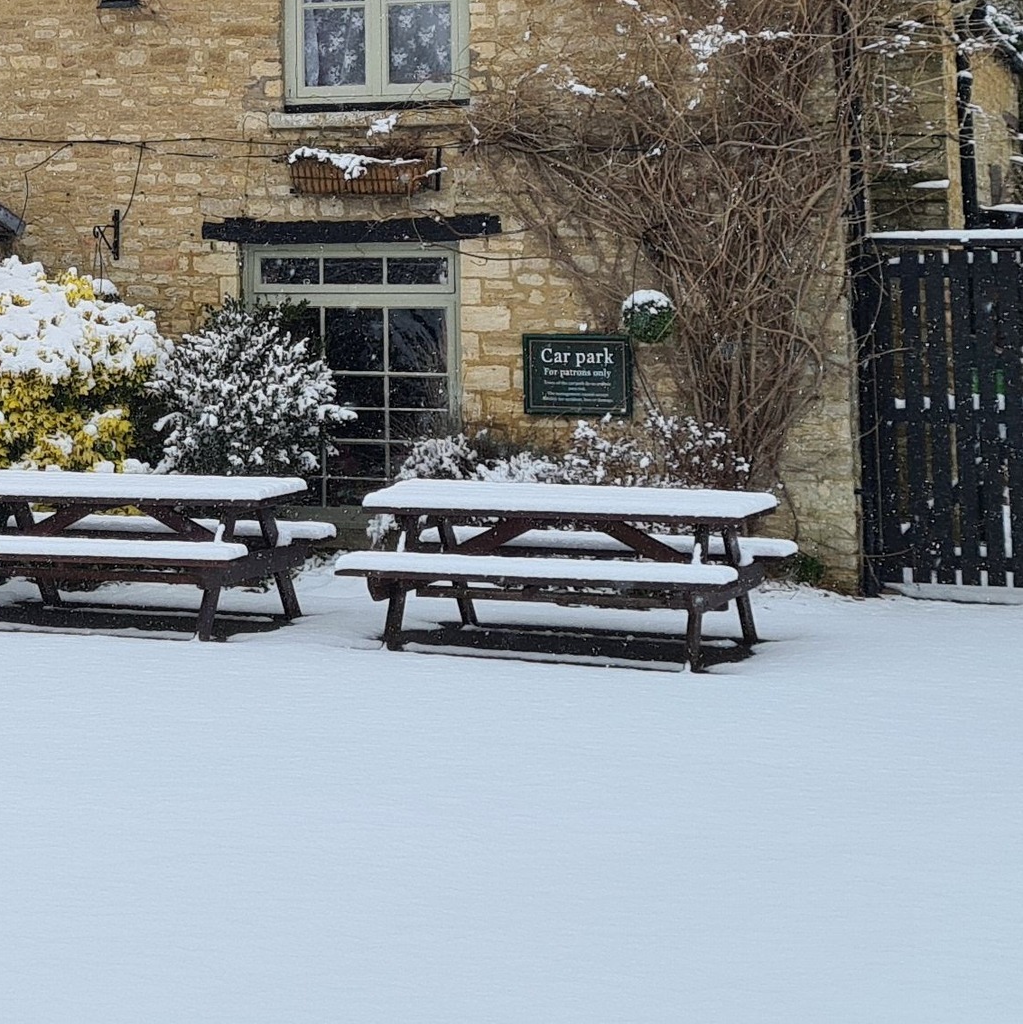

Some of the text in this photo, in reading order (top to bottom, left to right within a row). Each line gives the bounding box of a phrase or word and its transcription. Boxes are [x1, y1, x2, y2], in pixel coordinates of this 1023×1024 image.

[541, 347, 615, 368] Car park
[544, 367, 612, 379] For patrons only
